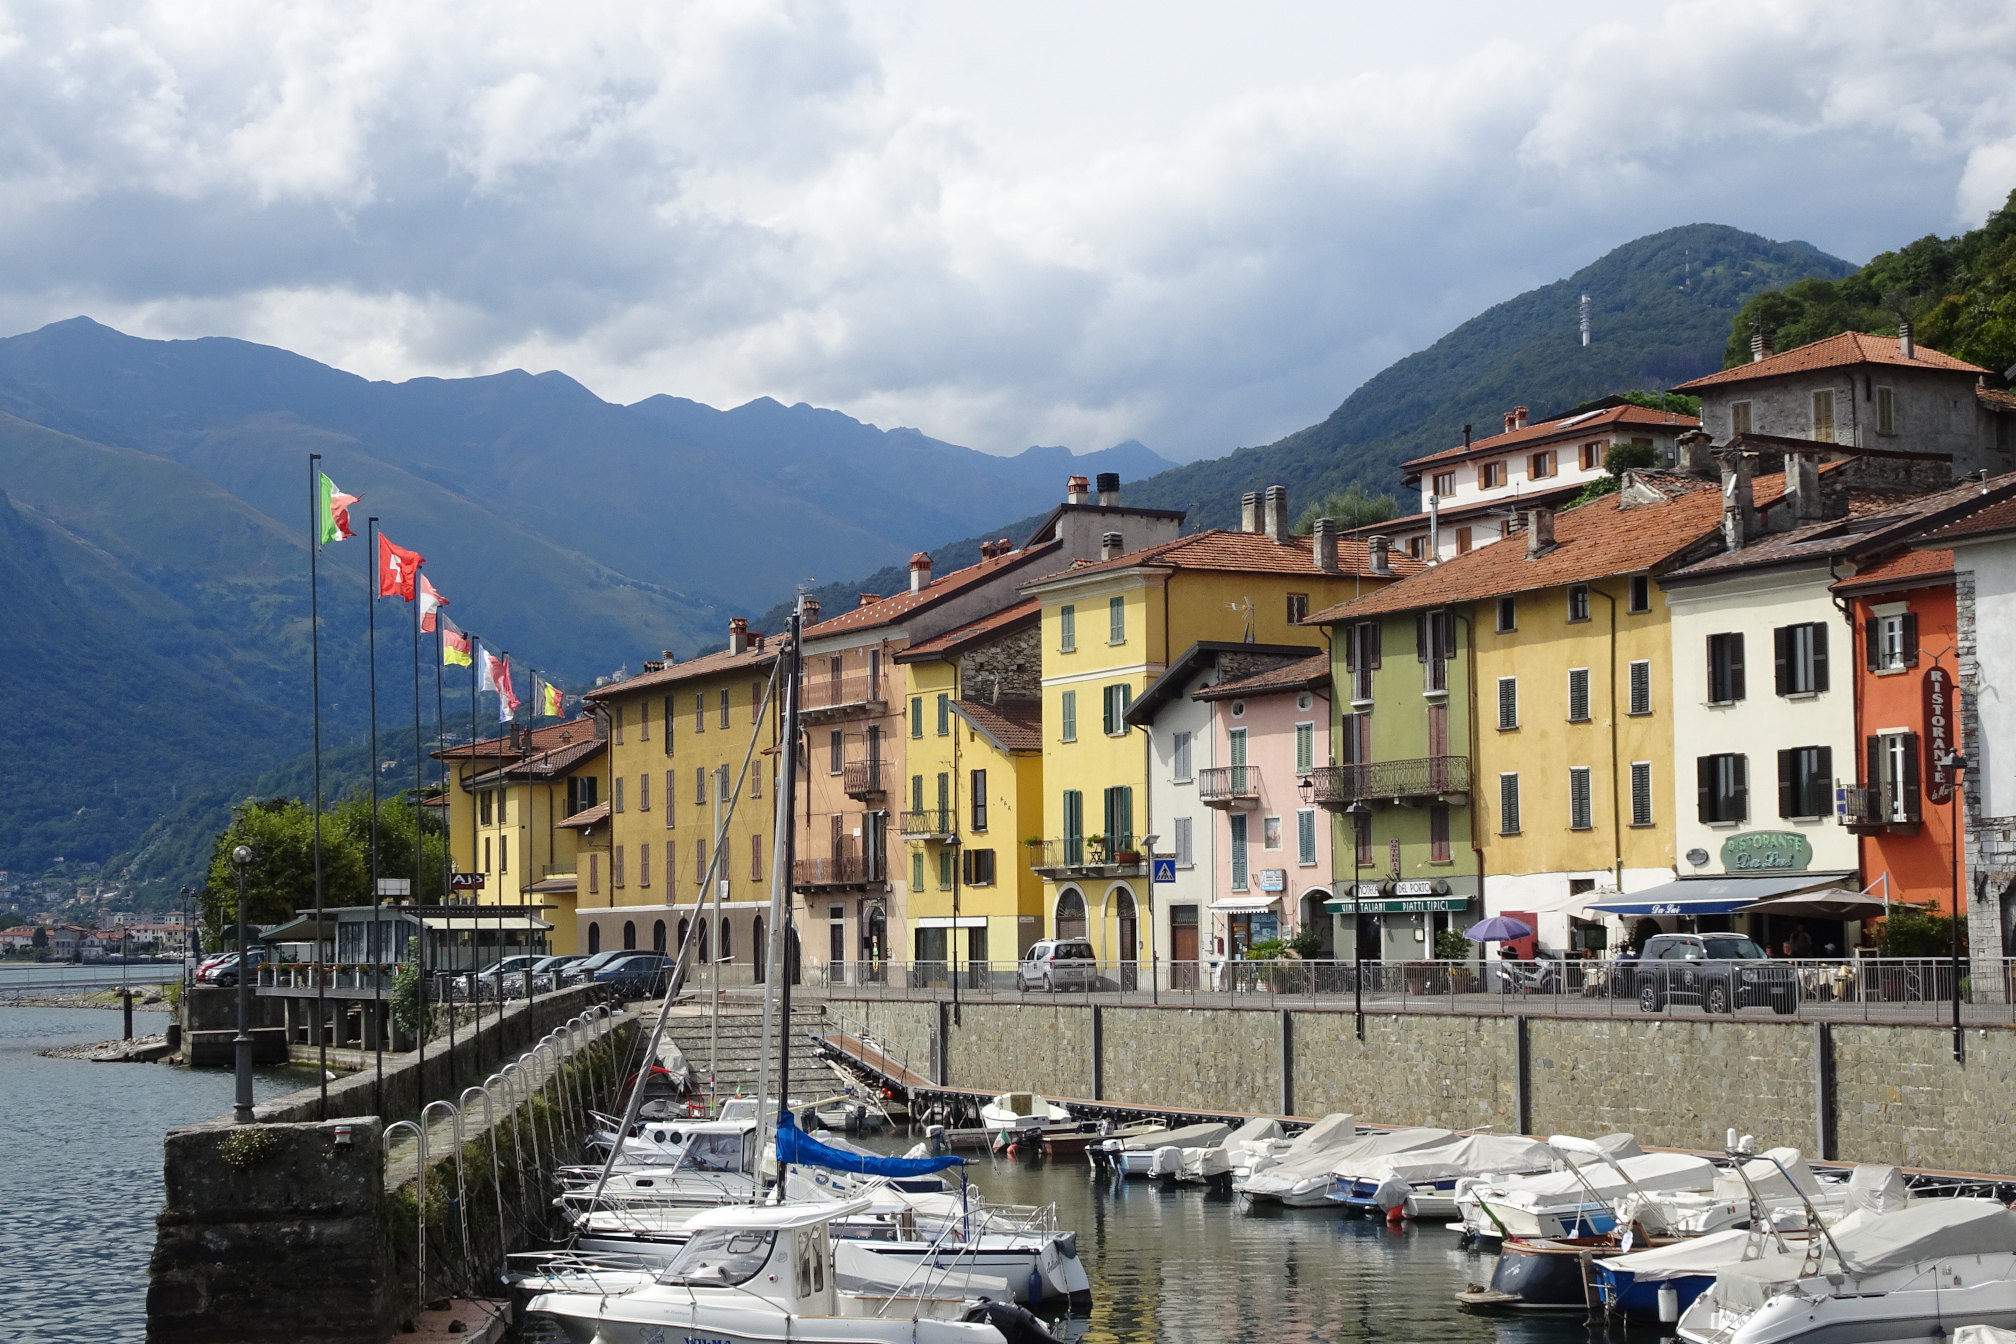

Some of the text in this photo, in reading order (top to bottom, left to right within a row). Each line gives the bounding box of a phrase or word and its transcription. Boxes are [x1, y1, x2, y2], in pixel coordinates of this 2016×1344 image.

[1930, 670, 1946, 782] RISTORANTE
[1728, 833, 1803, 853] RISTORANTE
[1390, 839, 1399, 872] OSTERIA
[1736, 851, 1794, 868] Da Lui
[1358, 882, 1431, 895] NOTECA DEL PORTO
[1342, 902, 1386, 912] VINI TALIANI
[1402, 900, 1449, 911] PIATTI TIPICI
[1651, 903, 1681, 914] Da Lui
